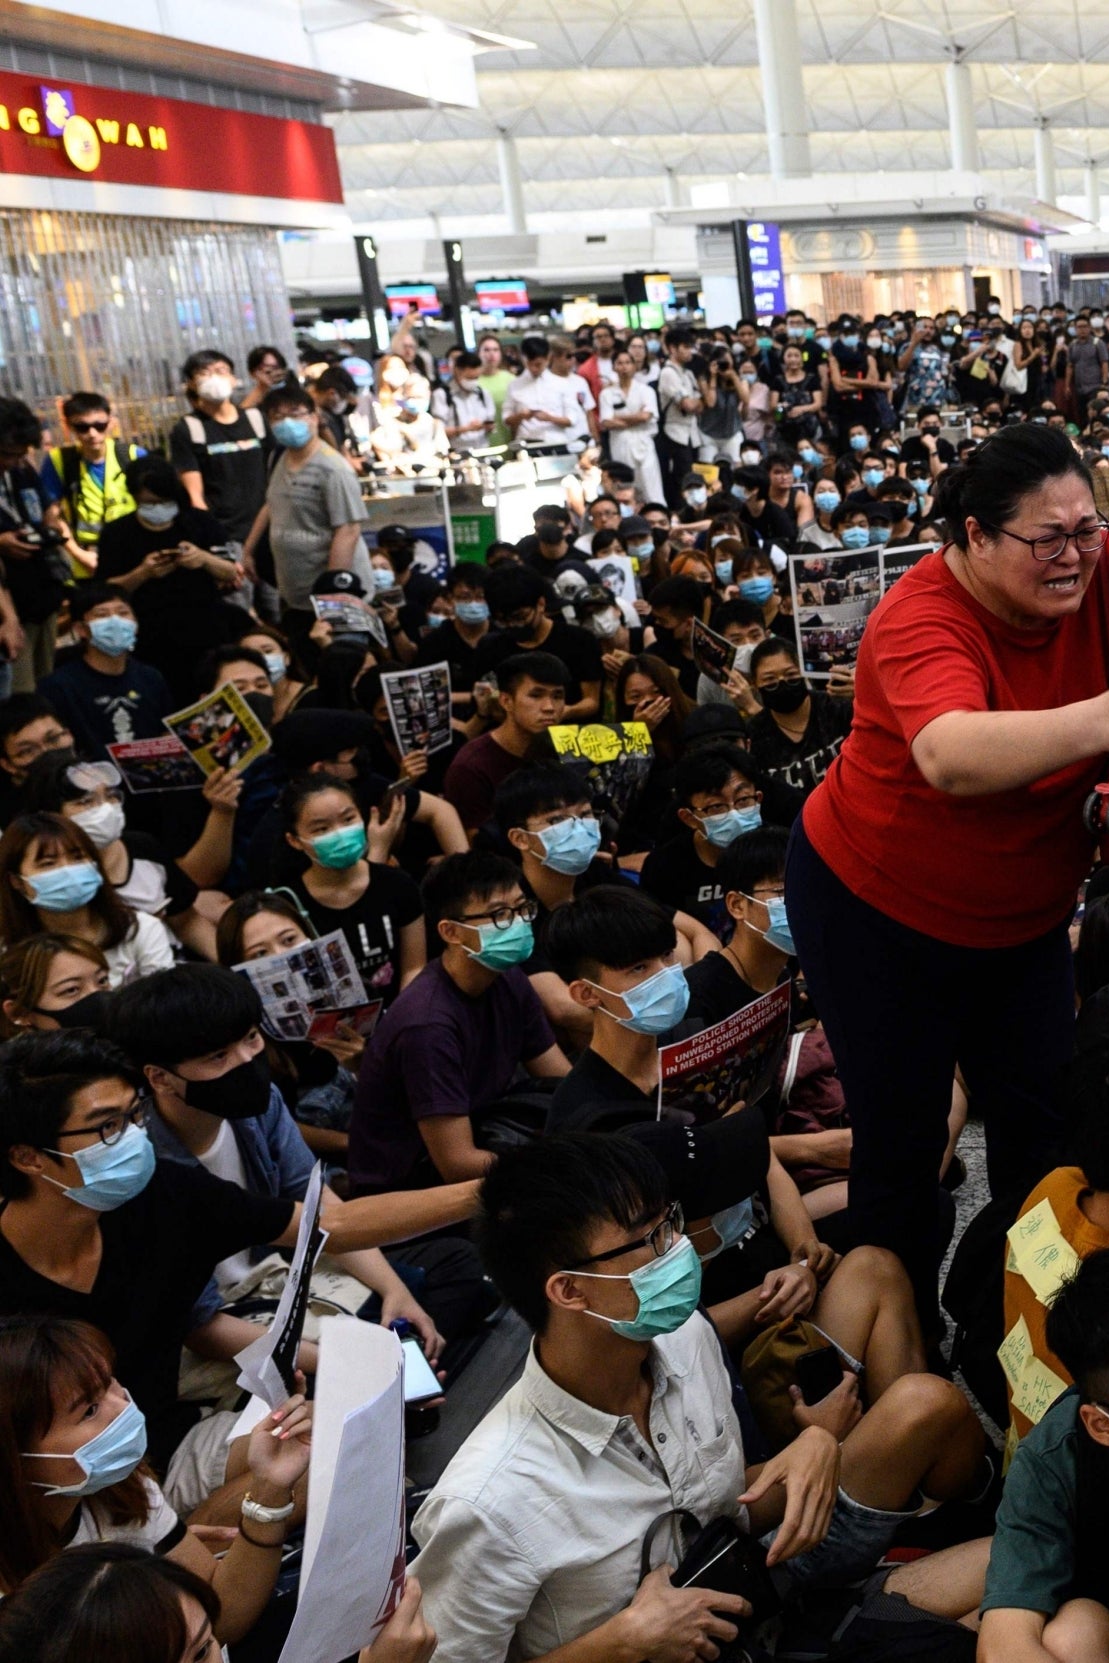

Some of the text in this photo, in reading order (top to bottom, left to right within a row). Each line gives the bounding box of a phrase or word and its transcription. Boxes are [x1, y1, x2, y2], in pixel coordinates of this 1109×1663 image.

[96, 118, 168, 151] WAH
[666, 1065, 678, 1076] IN
[680, 1049, 715, 1071] METRO
[716, 1030, 750, 1054] STATION
[751, 1011, 777, 1035] WITHIN
[674, 996, 784, 1063] UNWEAPONED PROTESTER
[691, 995, 772, 1047] POLICE SHOOT THE
[1033, 1376, 1053, 1399] HK
